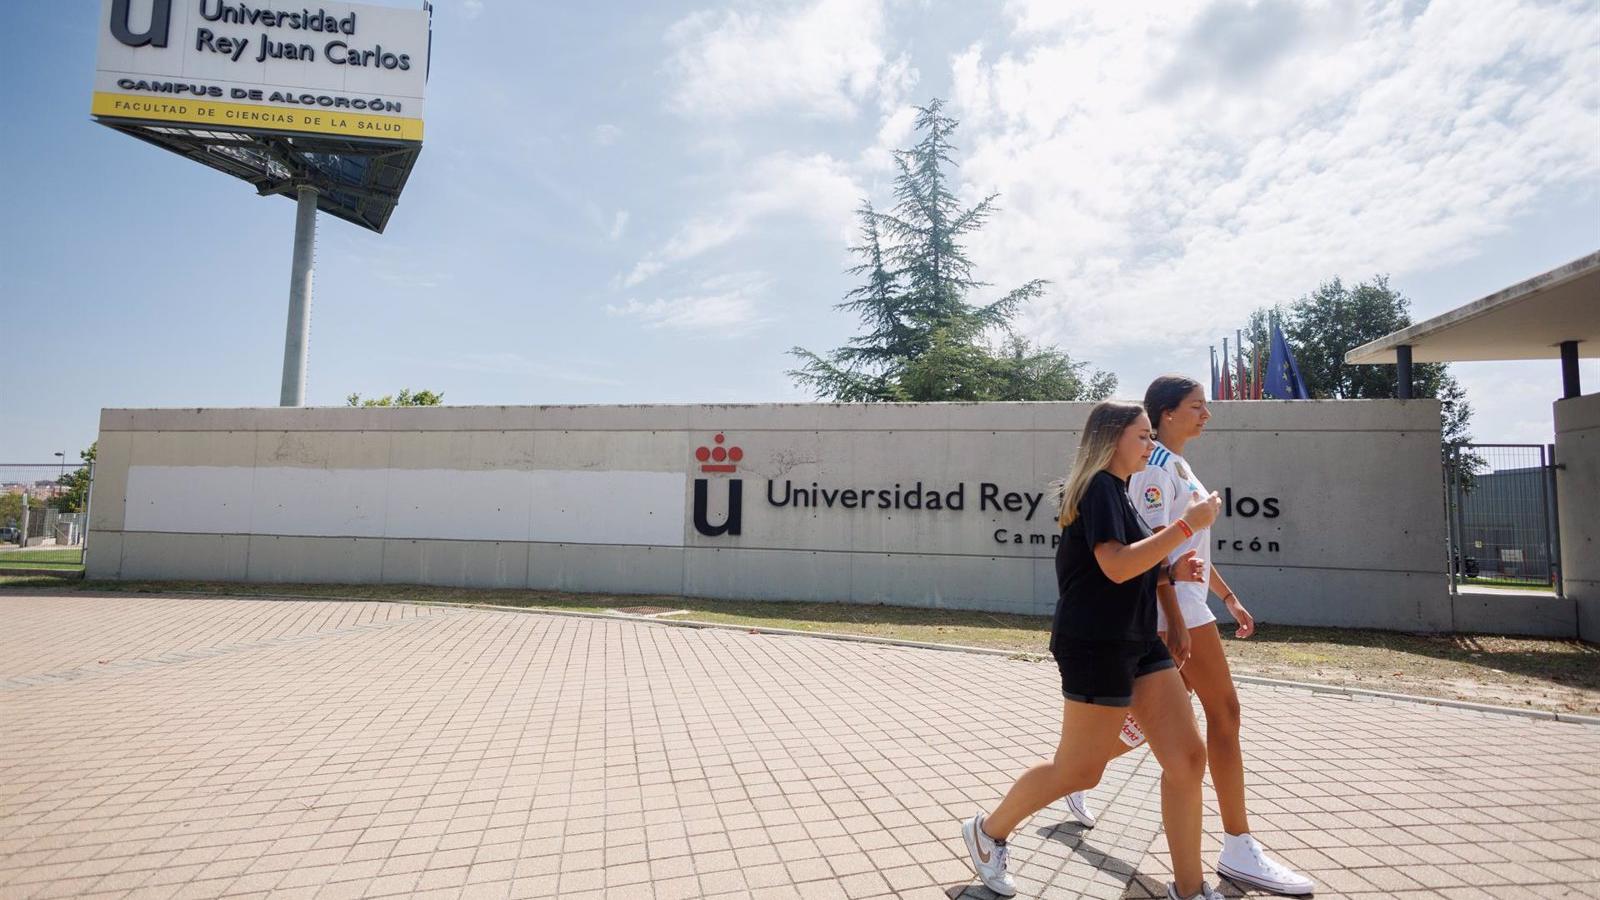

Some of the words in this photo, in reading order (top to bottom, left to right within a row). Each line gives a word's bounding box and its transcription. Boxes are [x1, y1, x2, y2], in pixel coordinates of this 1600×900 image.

[199, 0, 356, 35] Universidad
[195, 27, 249, 62] Rey
[256, 34, 315, 63] Juan
[324, 40, 411, 71] Carlos
[117, 78, 224, 98] CAMPUS
[230, 87, 264, 102] DE
[269, 91, 402, 113] ALCORCÓN
[114, 100, 188, 115] FACULTAD
[197, 107, 216, 117] DE
[225, 110, 294, 124] CIENCIAS
[304, 116, 321, 126] DE
[331, 119, 347, 128] LA
[357, 121, 402, 133] SALUD
[693, 479, 743, 537] u
[767, 481, 965, 511] Universidad
[980, 482, 1044, 521] Rey
[1225, 487, 1280, 518] los
[993, 528, 1062, 549] Camp
[1218, 536, 1280, 552] rcón
